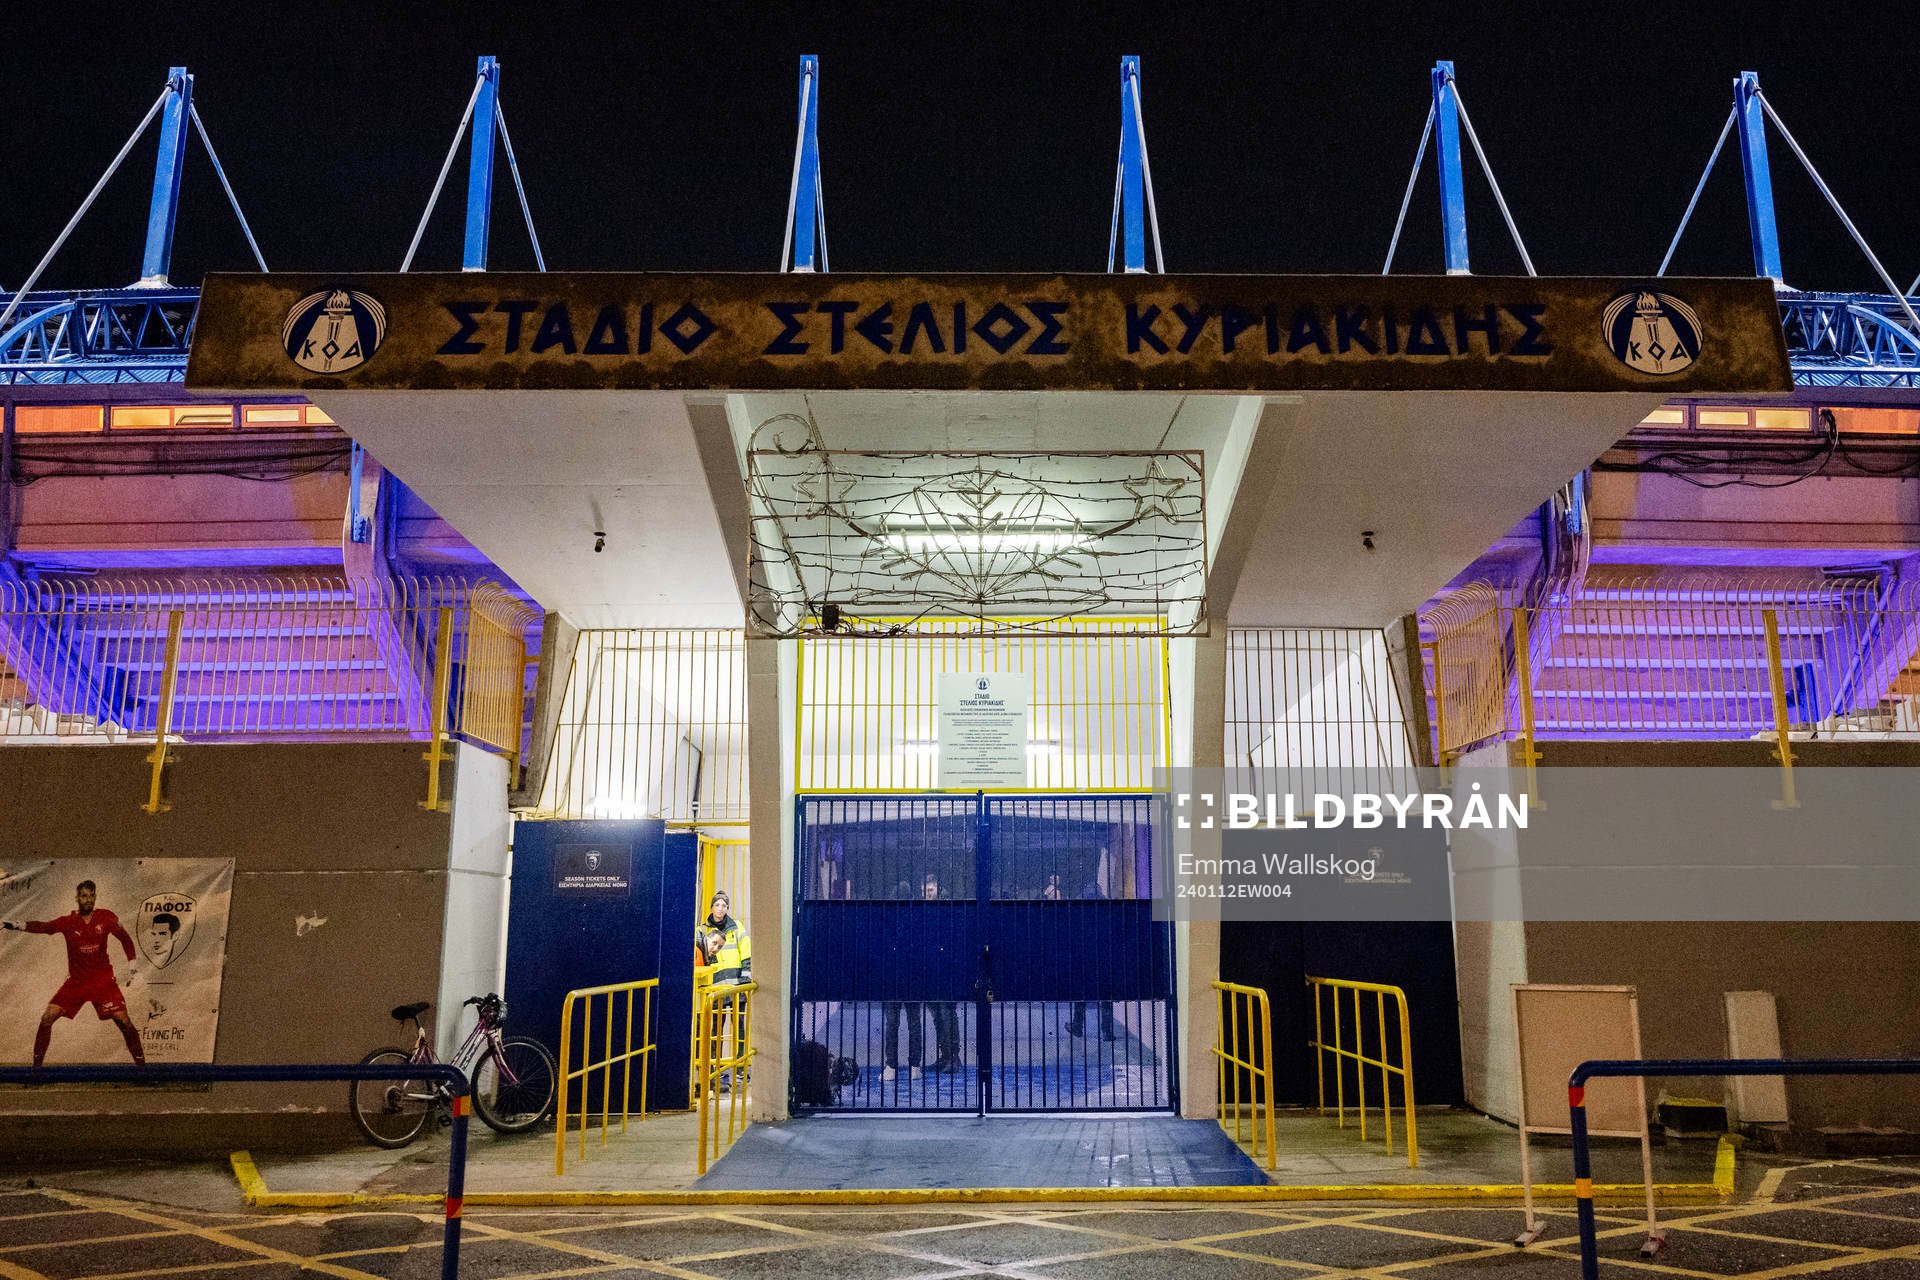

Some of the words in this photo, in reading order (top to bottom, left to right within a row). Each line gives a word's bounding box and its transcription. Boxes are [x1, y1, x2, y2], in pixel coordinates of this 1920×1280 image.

[435, 301, 717, 356] ΣΤΑΔΙΟ
[761, 301, 1070, 355] ΣΤΕΛΙΟΣ
[1125, 302, 1553, 356] ΚΥΡΙΑΚΙΔΗΣ
[144, 901, 193, 912] ΠΑΦΟΣ
[171, 1027, 185, 1040] PIG
